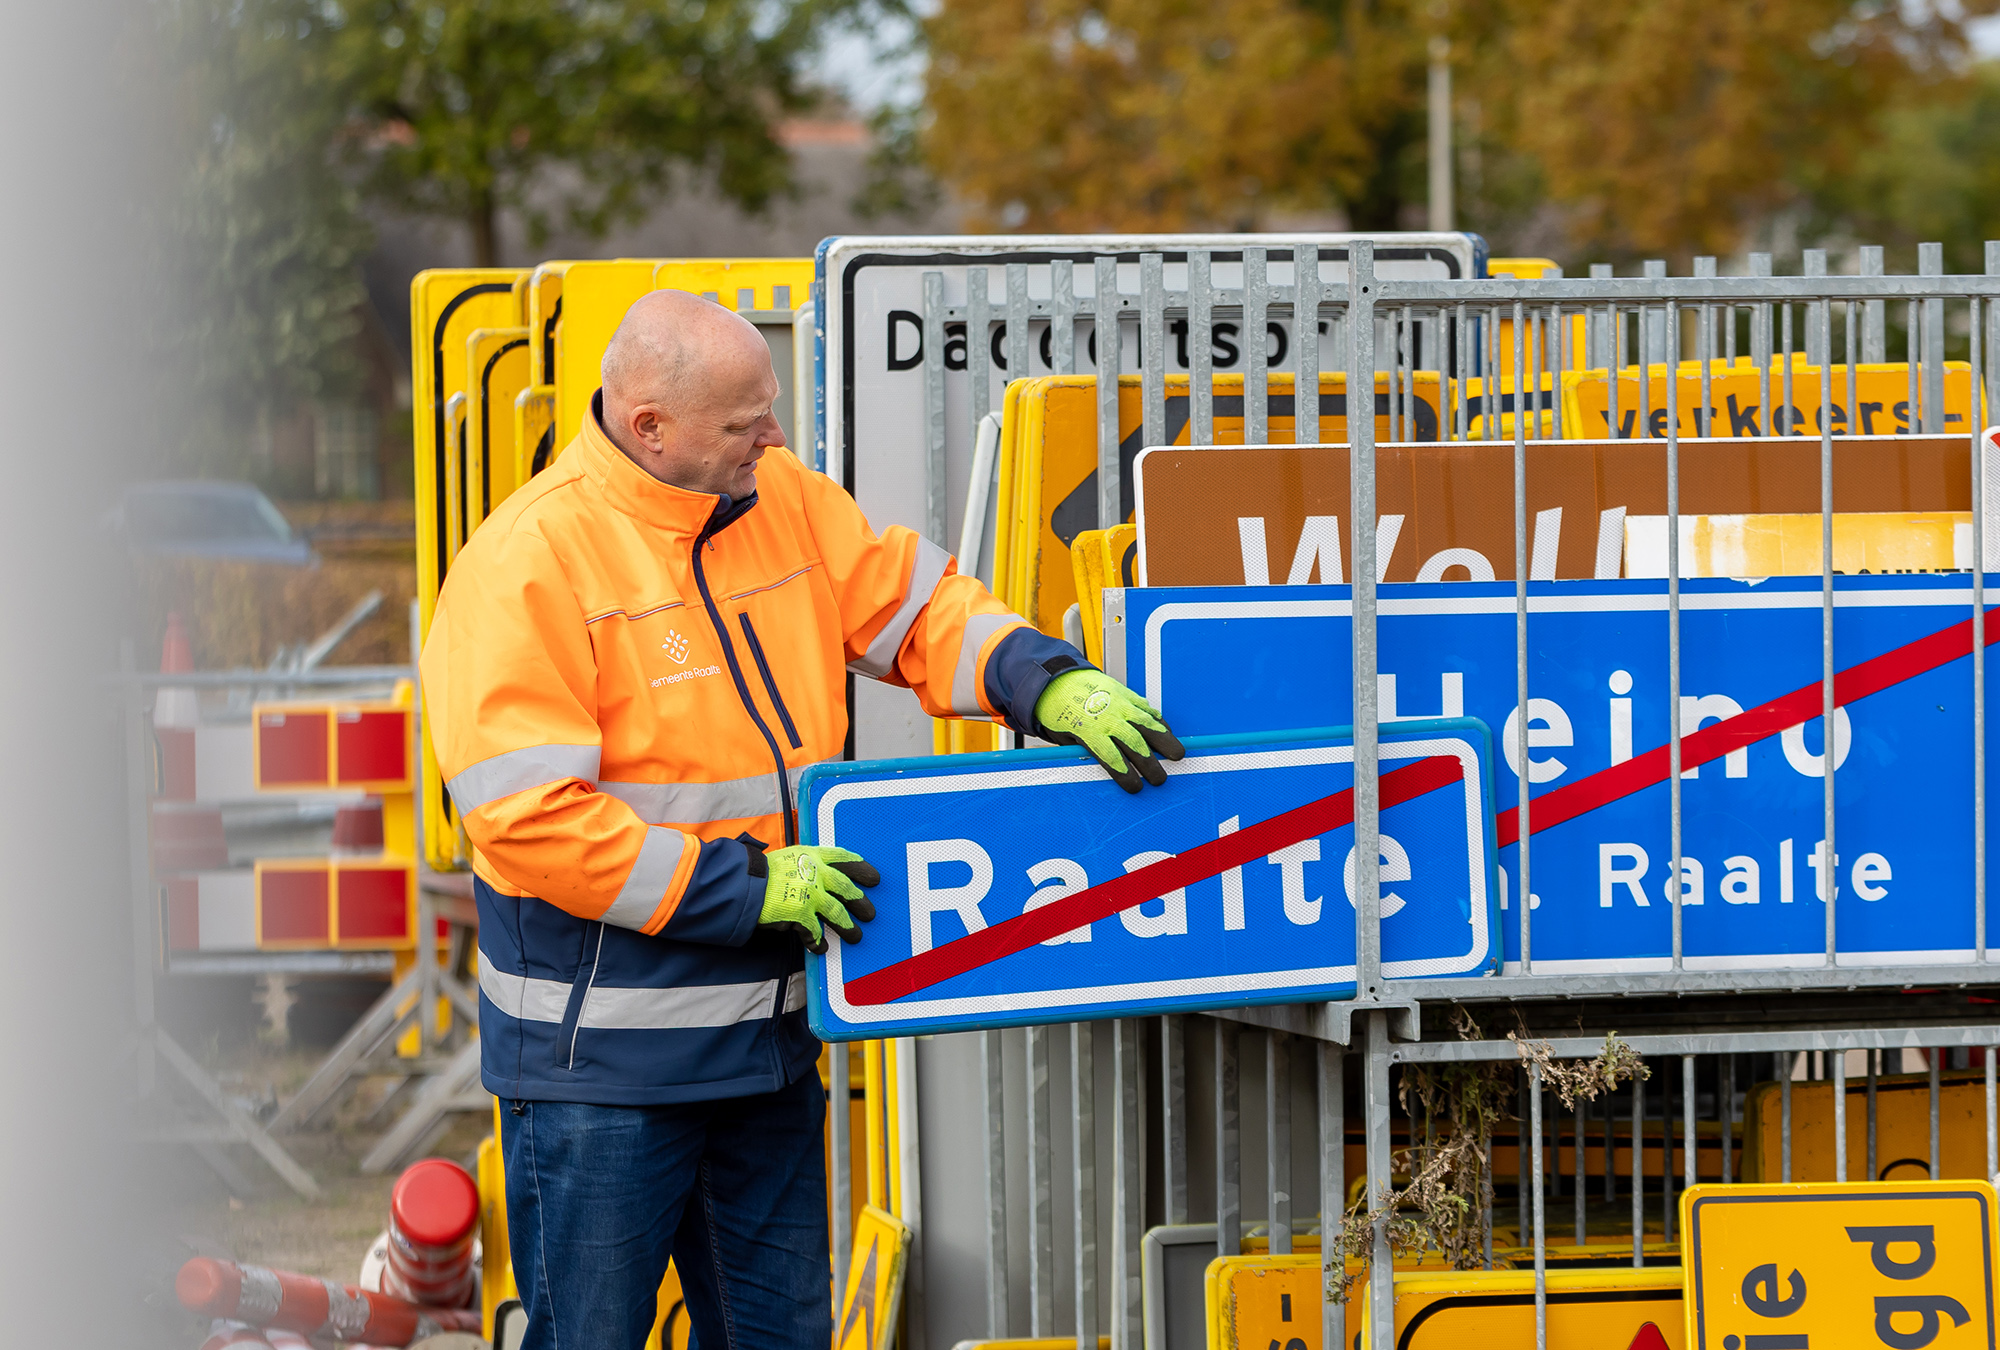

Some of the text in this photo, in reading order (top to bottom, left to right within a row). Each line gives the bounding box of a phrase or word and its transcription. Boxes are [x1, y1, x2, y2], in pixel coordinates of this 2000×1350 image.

[649, 664, 722, 688] emeente Raalte
[906, 814, 1412, 957] Raalte
[1599, 838, 1893, 908] Raalte
